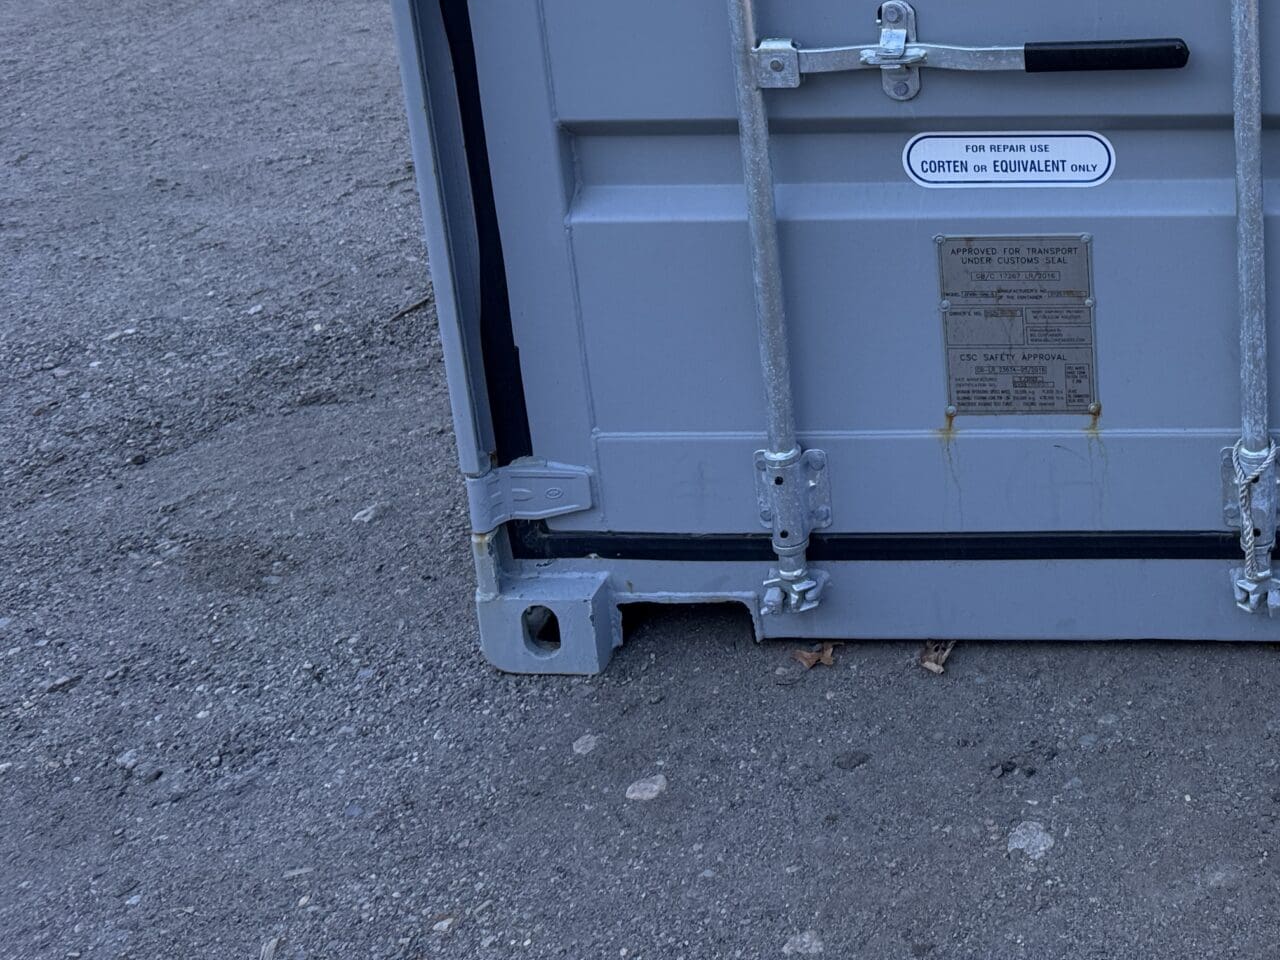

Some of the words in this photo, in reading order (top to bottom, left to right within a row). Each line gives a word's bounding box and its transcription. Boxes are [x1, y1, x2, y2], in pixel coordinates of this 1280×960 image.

[965, 145, 986, 153] FOR
[989, 144, 1026, 153] REPAIR
[1030, 144, 1050, 153] USE
[921, 160, 968, 173] CORTEN
[973, 164, 987, 173] OR
[993, 159, 1067, 173] EQUIVALENT
[1070, 163, 1098, 172] ONLY
[950, 247, 997, 256] APPROVED
[1003, 247, 1021, 255] FOR
[1027, 247, 1079, 255] TRANSPORT
[961, 257, 992, 265] UNDER
[997, 256, 1040, 265] CUSTOMS
[1045, 256, 1068, 264] SEAL
[959, 353, 978, 362] CSC
[983, 352, 1016, 361] SAFETY
[1021, 353, 1068, 361] APPROVAL
